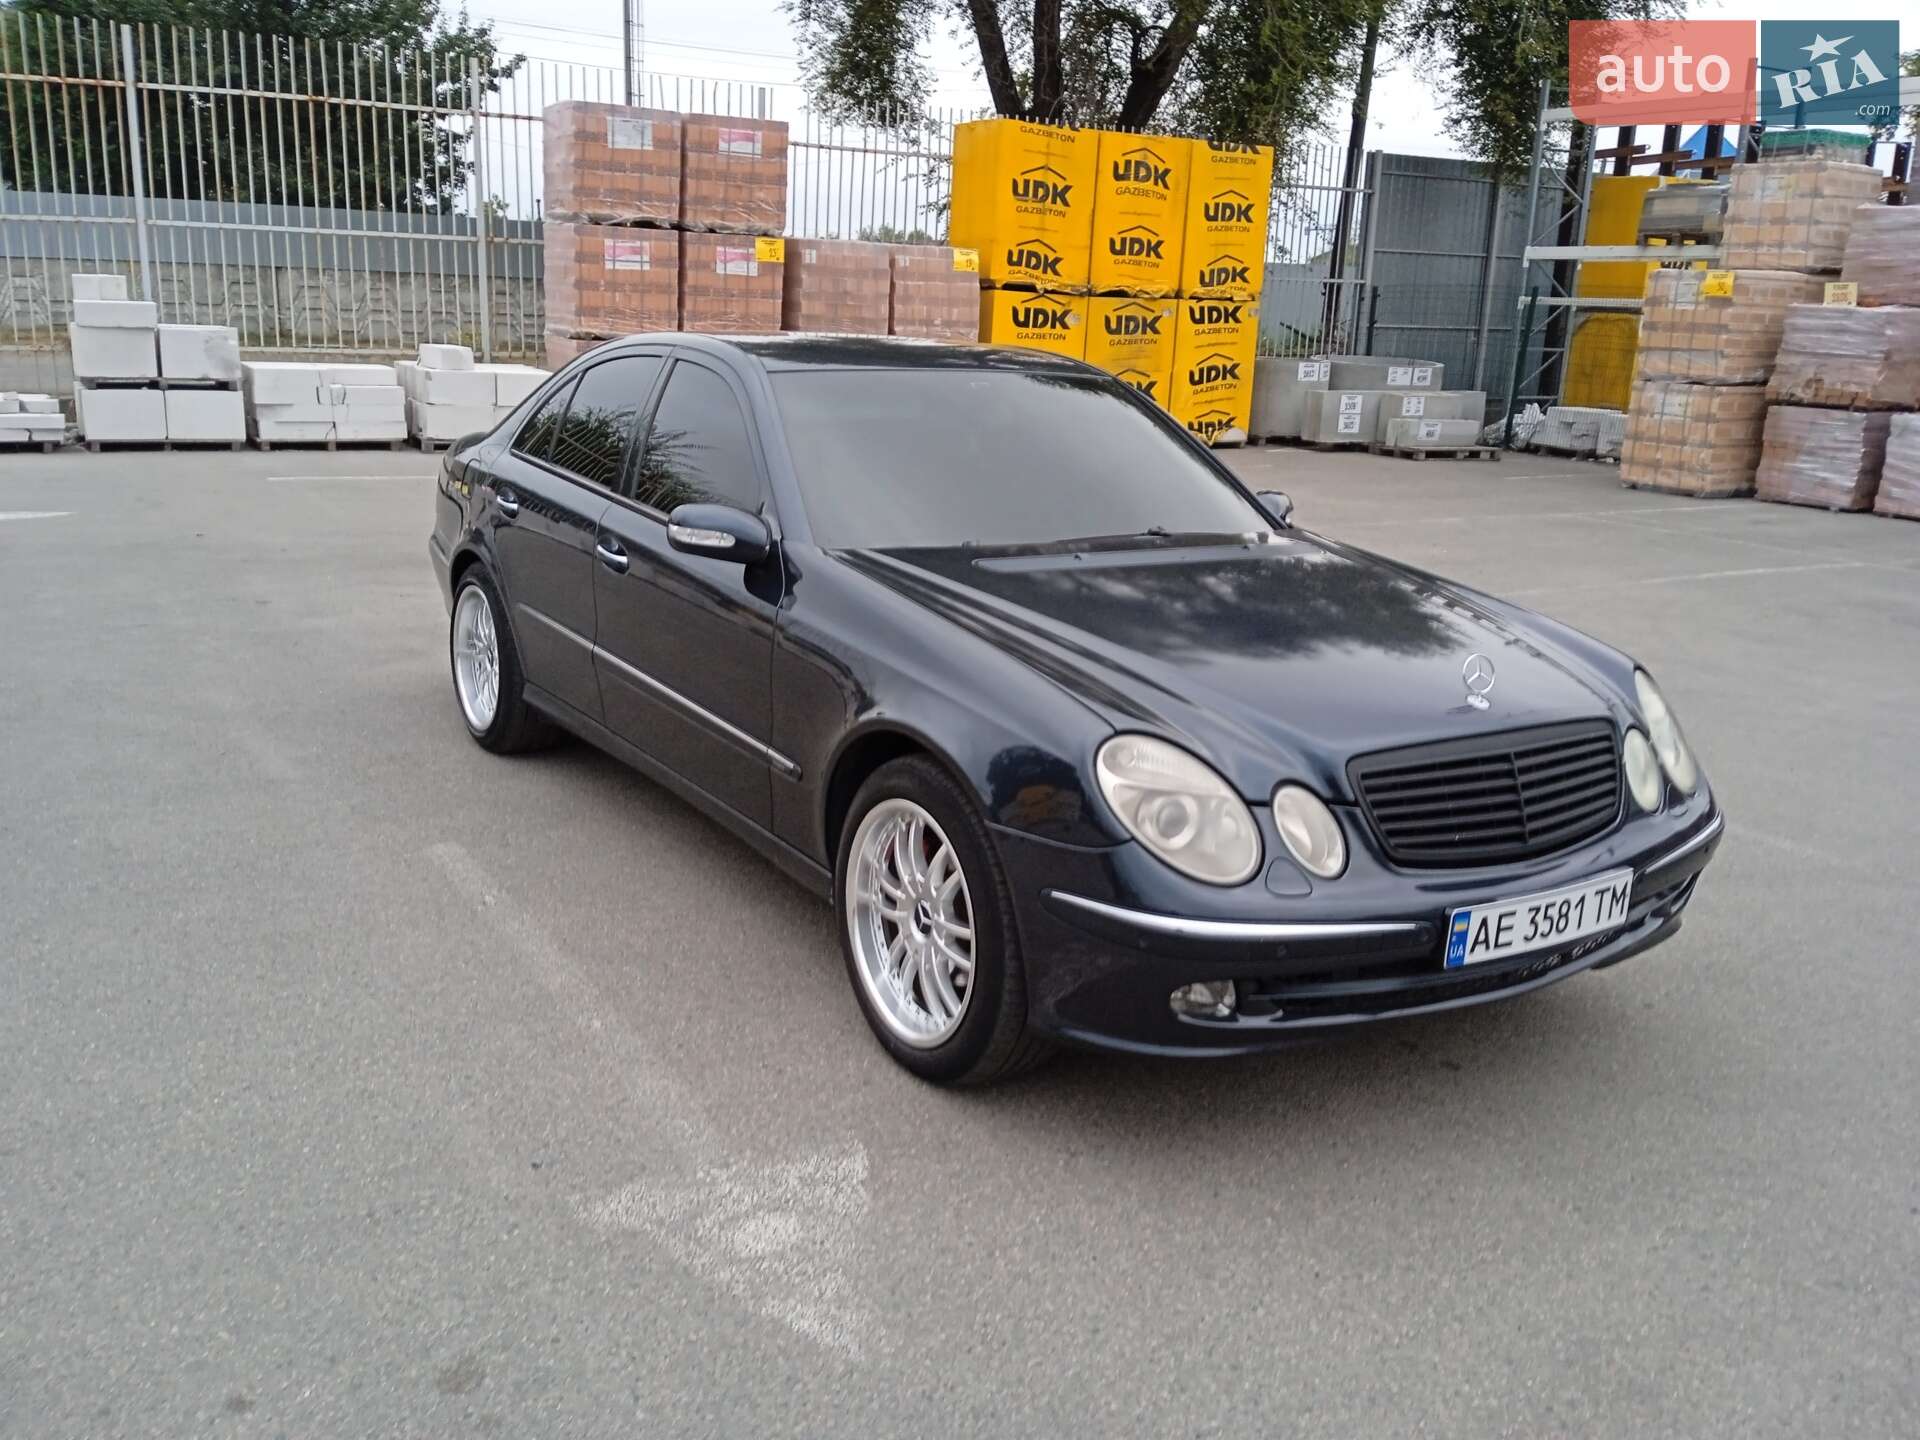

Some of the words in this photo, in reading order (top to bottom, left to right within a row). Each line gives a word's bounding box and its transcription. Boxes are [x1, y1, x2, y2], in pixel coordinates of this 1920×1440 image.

[1020, 125, 1075, 143] GAZBETON
[1211, 155, 1256, 165] GAZBETON
[1113, 159, 1172, 190] UDK
[1012, 178, 1073, 207] UDK
[1115, 186, 1167, 201] GAZBETON
[1016, 205, 1066, 218] GAZBETON
[1204, 202, 1254, 223] UDK
[1207, 225, 1250, 233] GAZBETON
[1109, 237, 1164, 260] UDK
[1007, 249, 1064, 277] UDK
[1113, 259, 1160, 269] GAZBETON
[1199, 266, 1250, 287] UDK
[1012, 305, 1073, 330] UDK
[1104, 314, 1162, 335] UDK
[1189, 305, 1242, 325] UDK
[1016, 331, 1066, 341] GAZBETON
[1194, 328, 1239, 336] GAZBETON
[1109, 338, 1157, 346] GAZBETON
[1189, 363, 1240, 386] UDK
[1192, 383, 1237, 396] GAZBETON
[1469, 910, 1517, 955] AE
[1523, 893, 1586, 943] 3581
[1594, 880, 1629, 924] TM
[1450, 944, 1464, 957] UA
